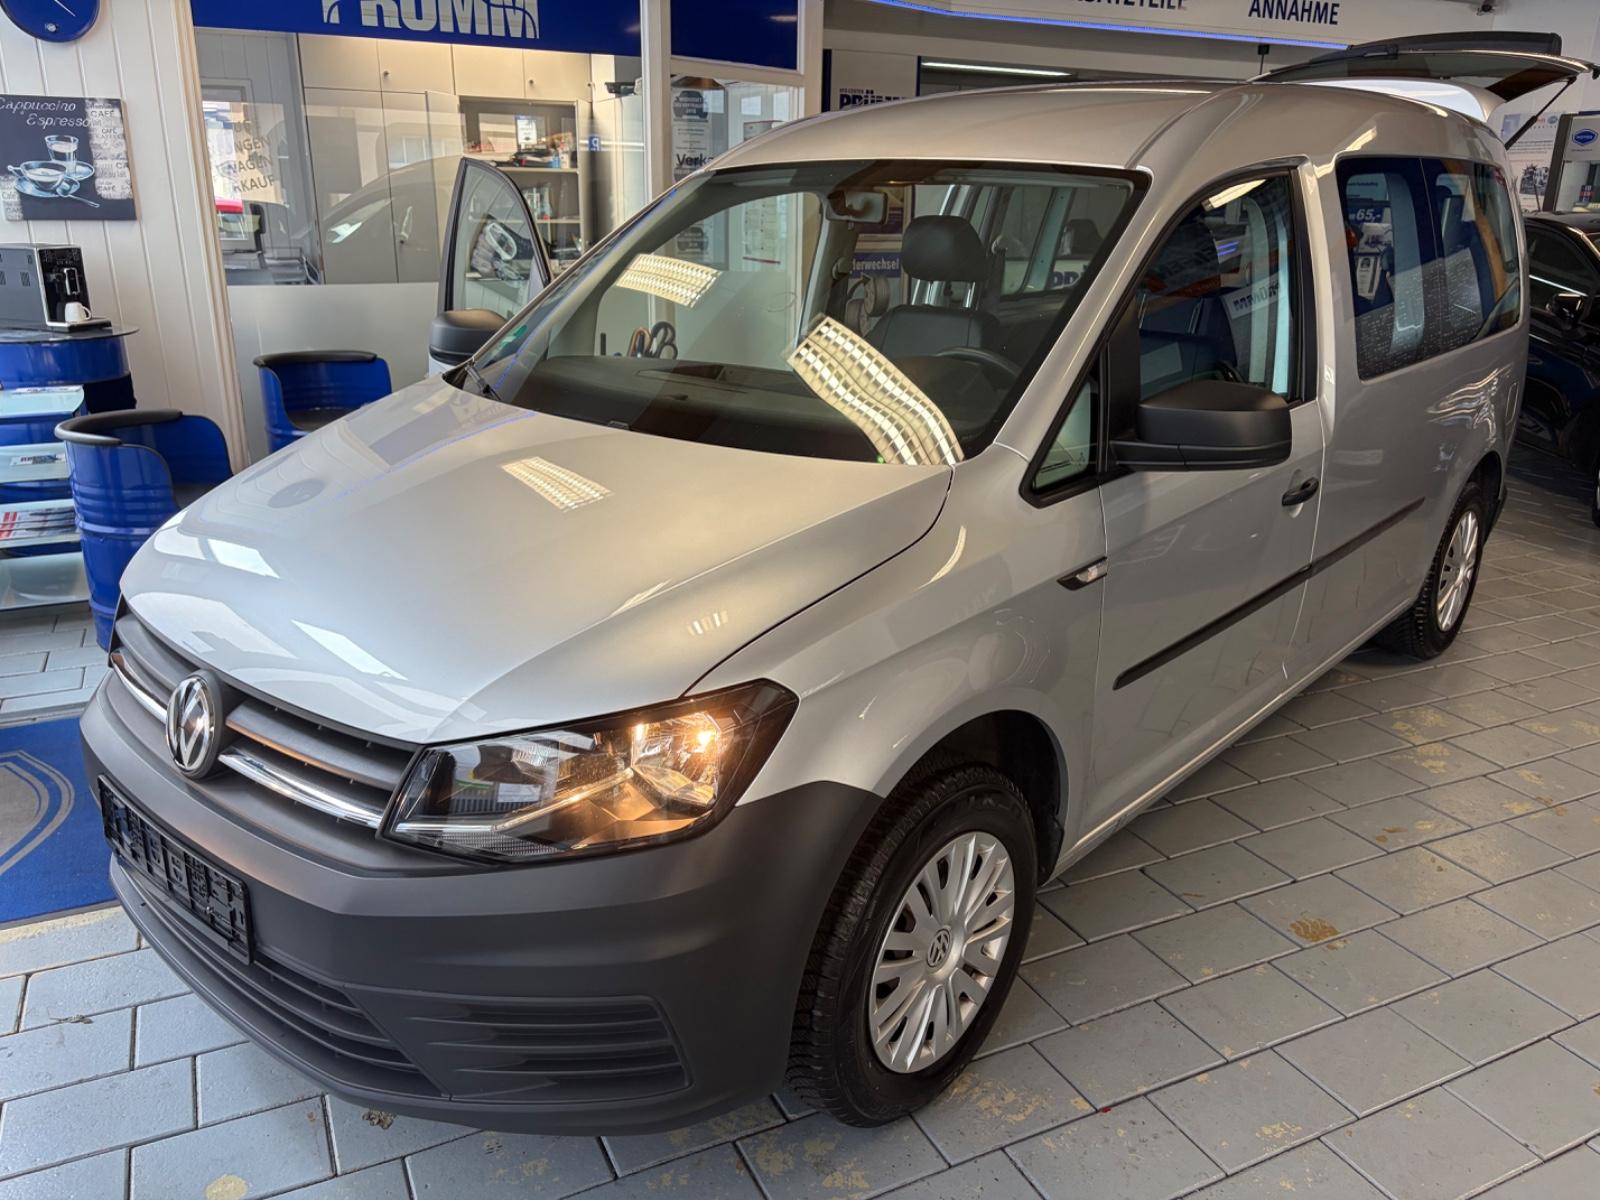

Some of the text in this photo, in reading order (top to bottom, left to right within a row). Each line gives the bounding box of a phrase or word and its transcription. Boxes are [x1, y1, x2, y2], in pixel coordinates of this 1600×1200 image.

[1248, 0, 1340, 25] ANNAHME
[0, 97, 76, 113] Cappuccino
[26, 113, 89, 129] Espresso
